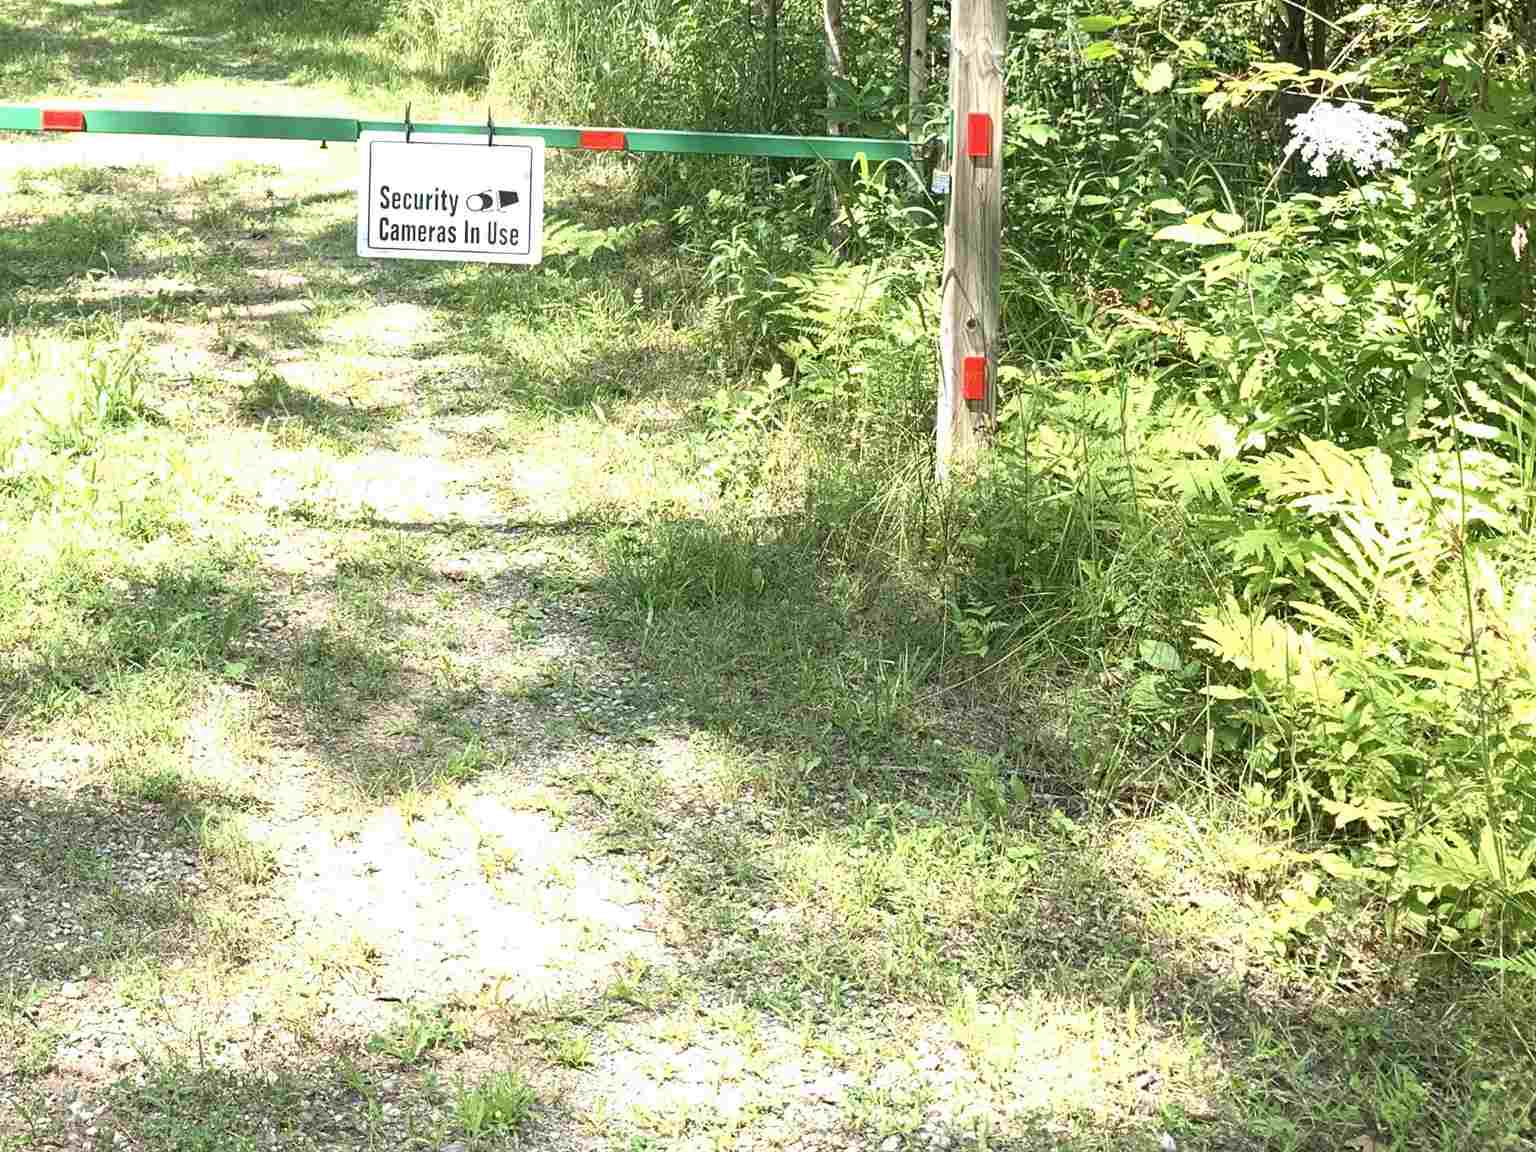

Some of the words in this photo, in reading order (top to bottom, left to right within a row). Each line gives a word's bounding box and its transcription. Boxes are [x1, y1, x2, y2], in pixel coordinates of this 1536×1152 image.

[379, 185, 459, 217] Security
[379, 216, 457, 244] Cameras
[464, 219, 480, 245] In
[487, 220, 520, 247] Use
